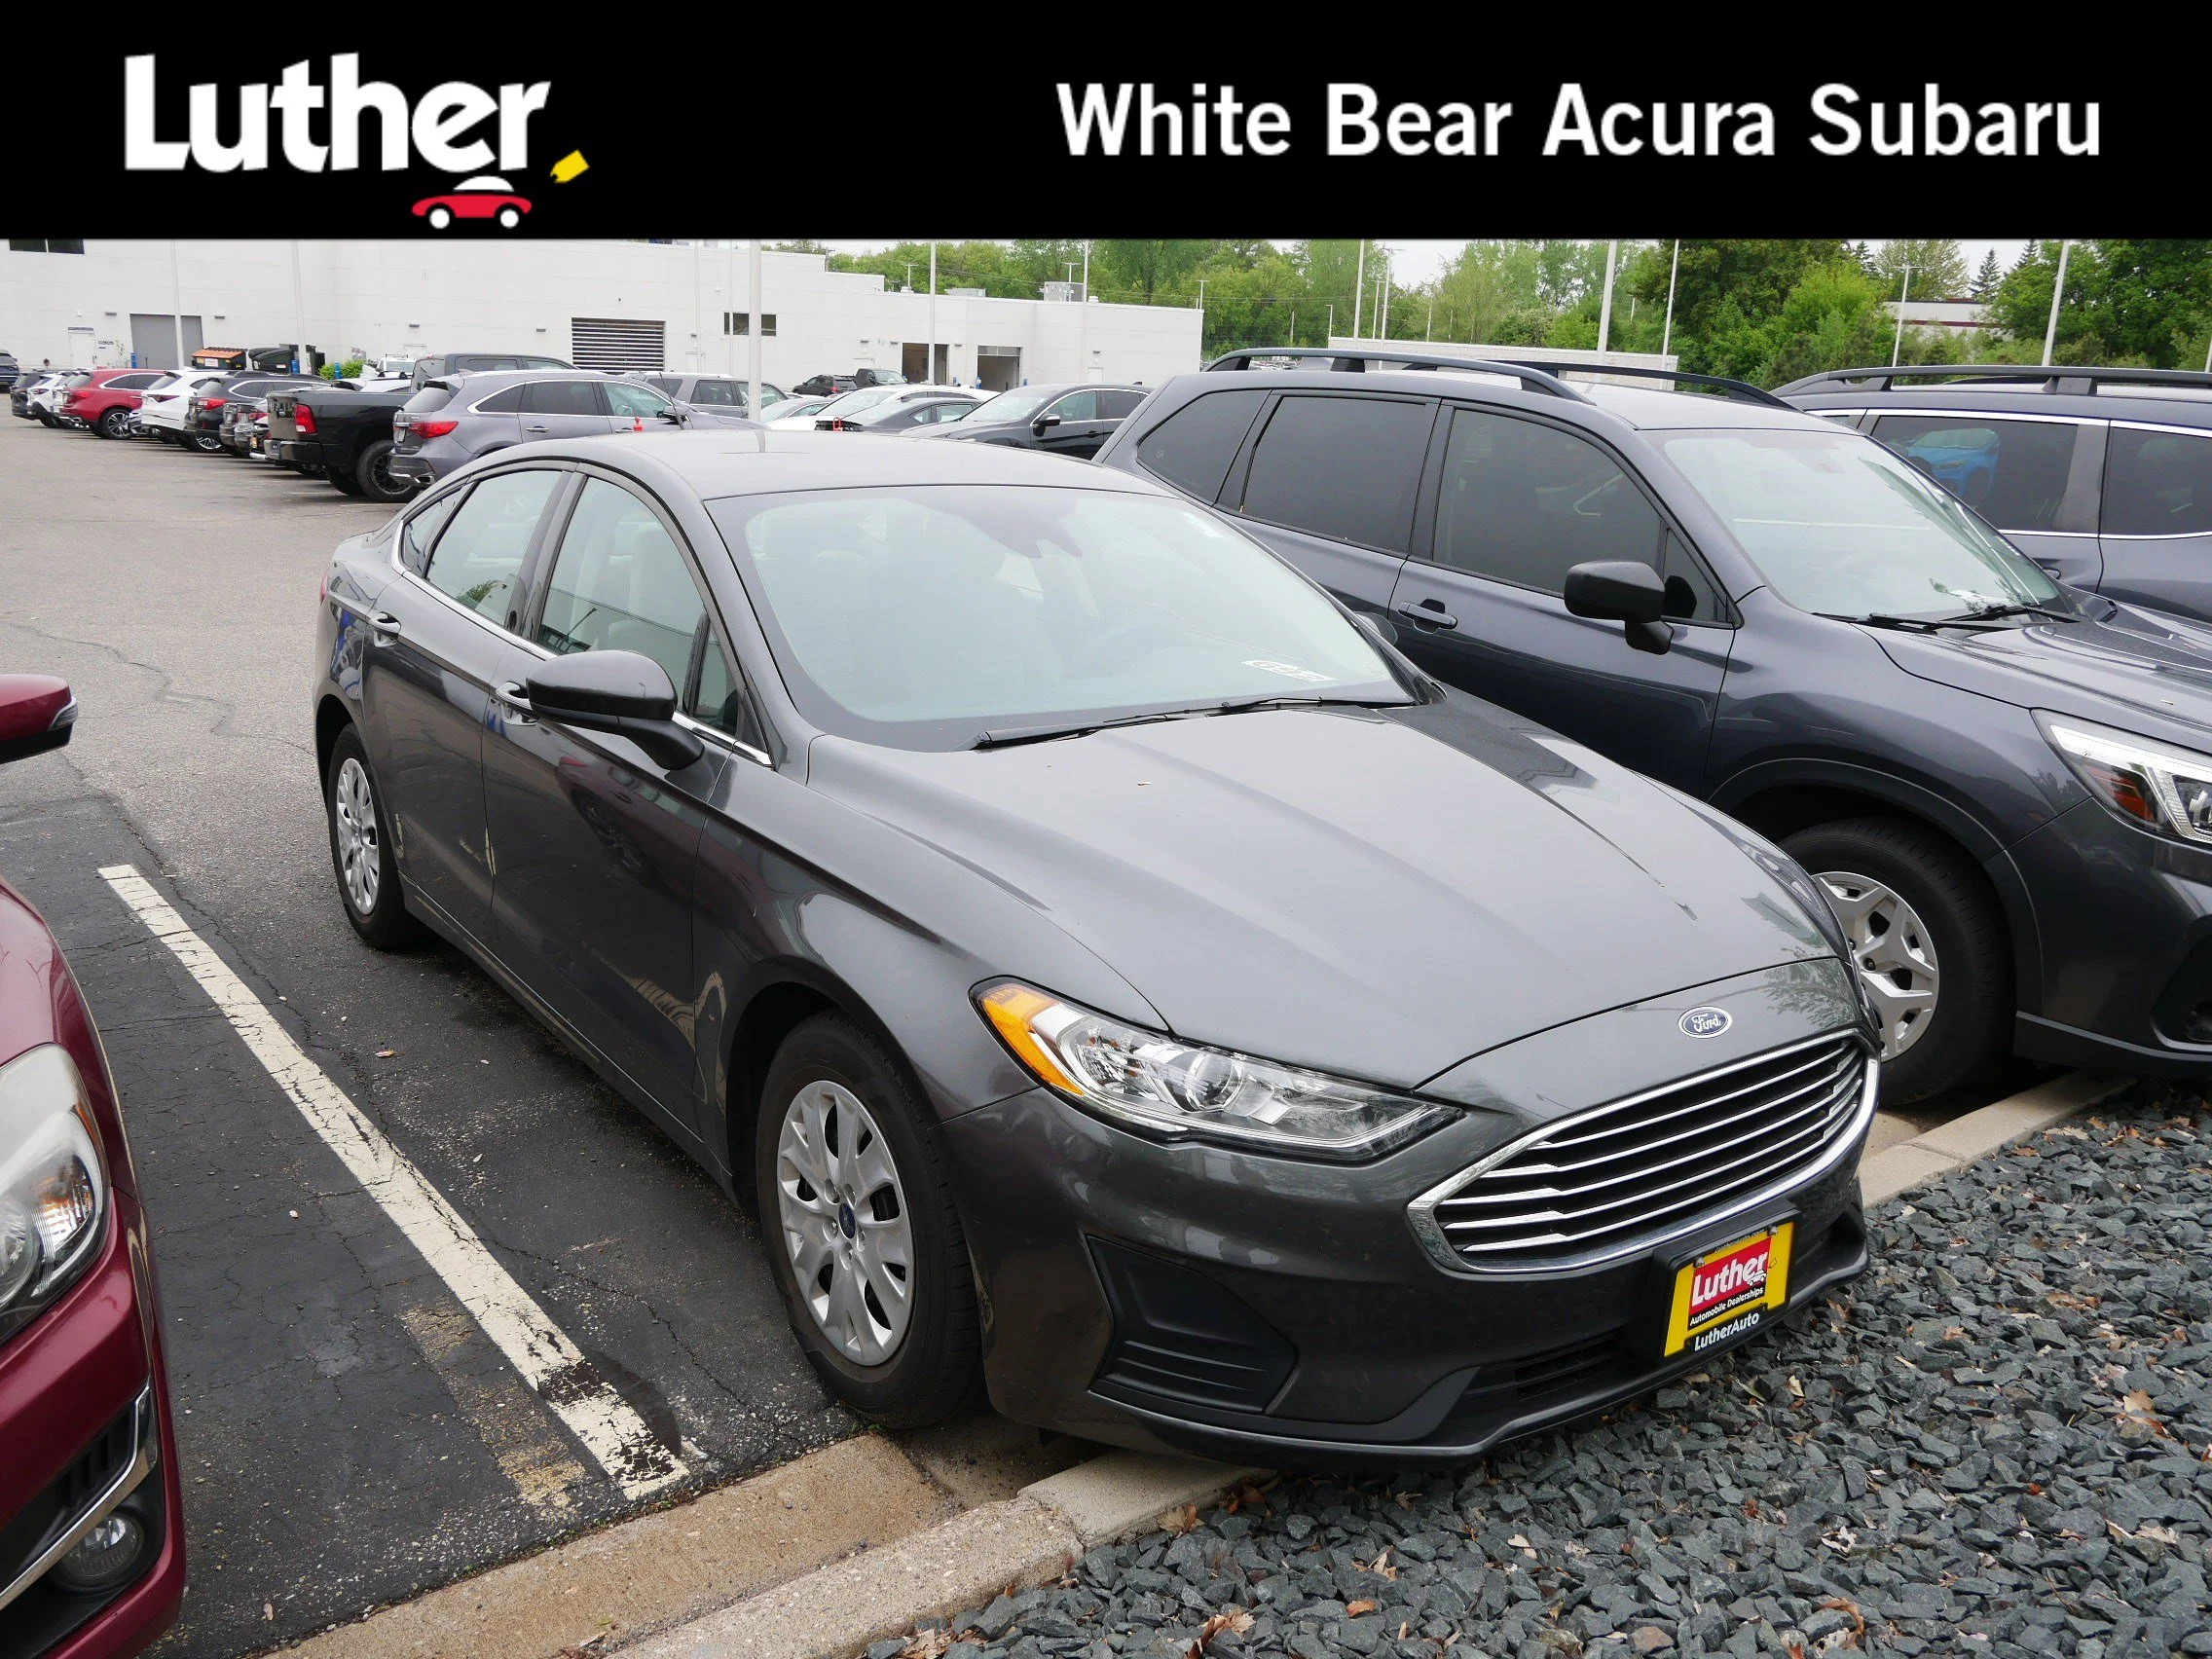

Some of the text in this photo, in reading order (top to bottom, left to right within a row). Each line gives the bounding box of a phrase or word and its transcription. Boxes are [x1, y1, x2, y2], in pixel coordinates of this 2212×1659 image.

[1691, 1014, 1721, 1033] Ford
[1691, 1251, 1768, 1307] Luther
[1690, 1286, 1763, 1326] Automobile Dealerships
[1694, 1312, 1760, 1351] LutherAuto
